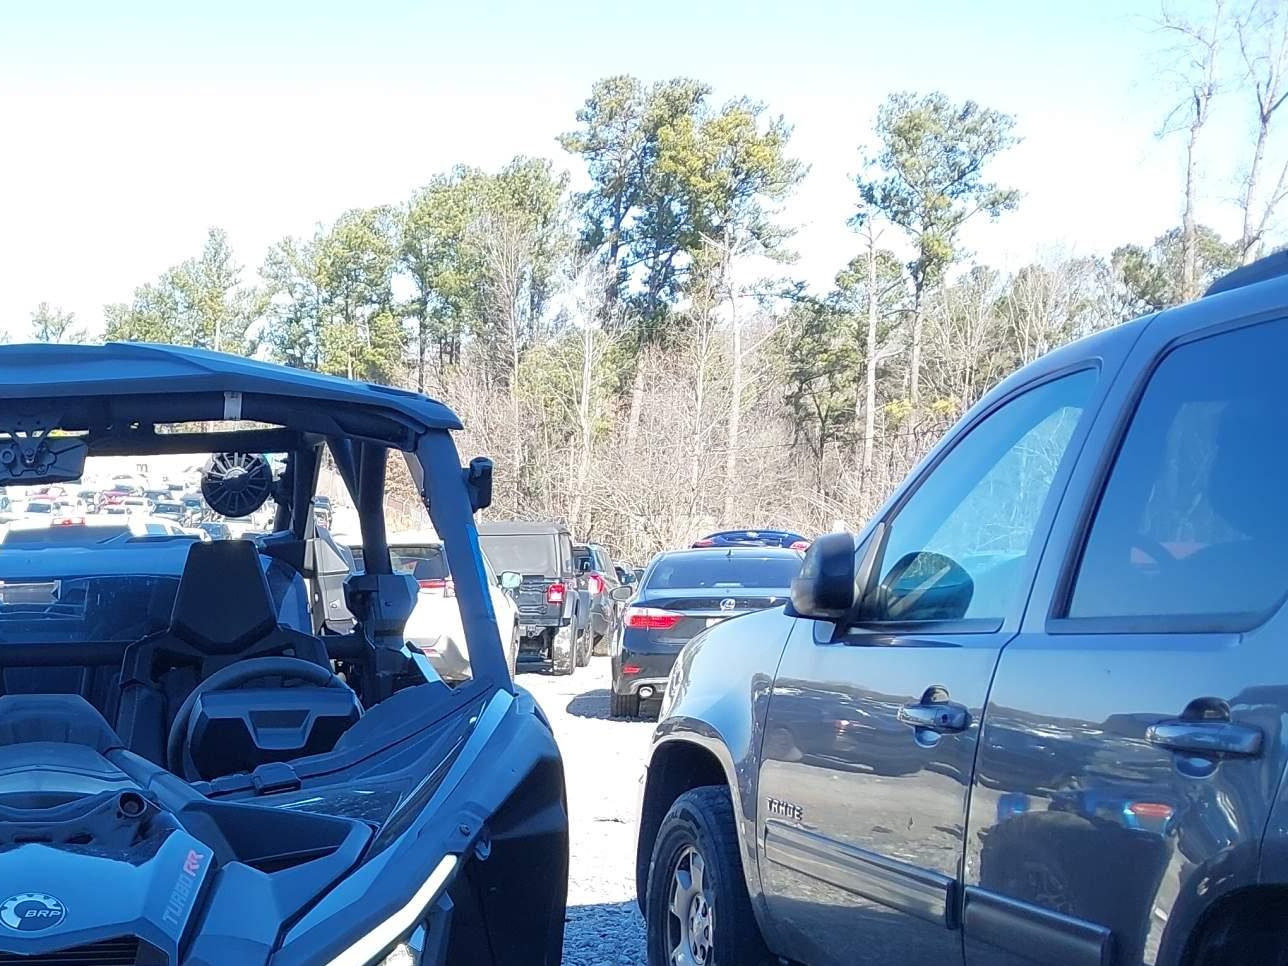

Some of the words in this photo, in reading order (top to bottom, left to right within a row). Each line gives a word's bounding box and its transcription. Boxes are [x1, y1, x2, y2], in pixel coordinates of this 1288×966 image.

[767, 796, 802, 821] TAHOE
[162, 872, 194, 926] TURBO
[183, 848, 204, 878] RR
[24, 909, 62, 918] BRP
